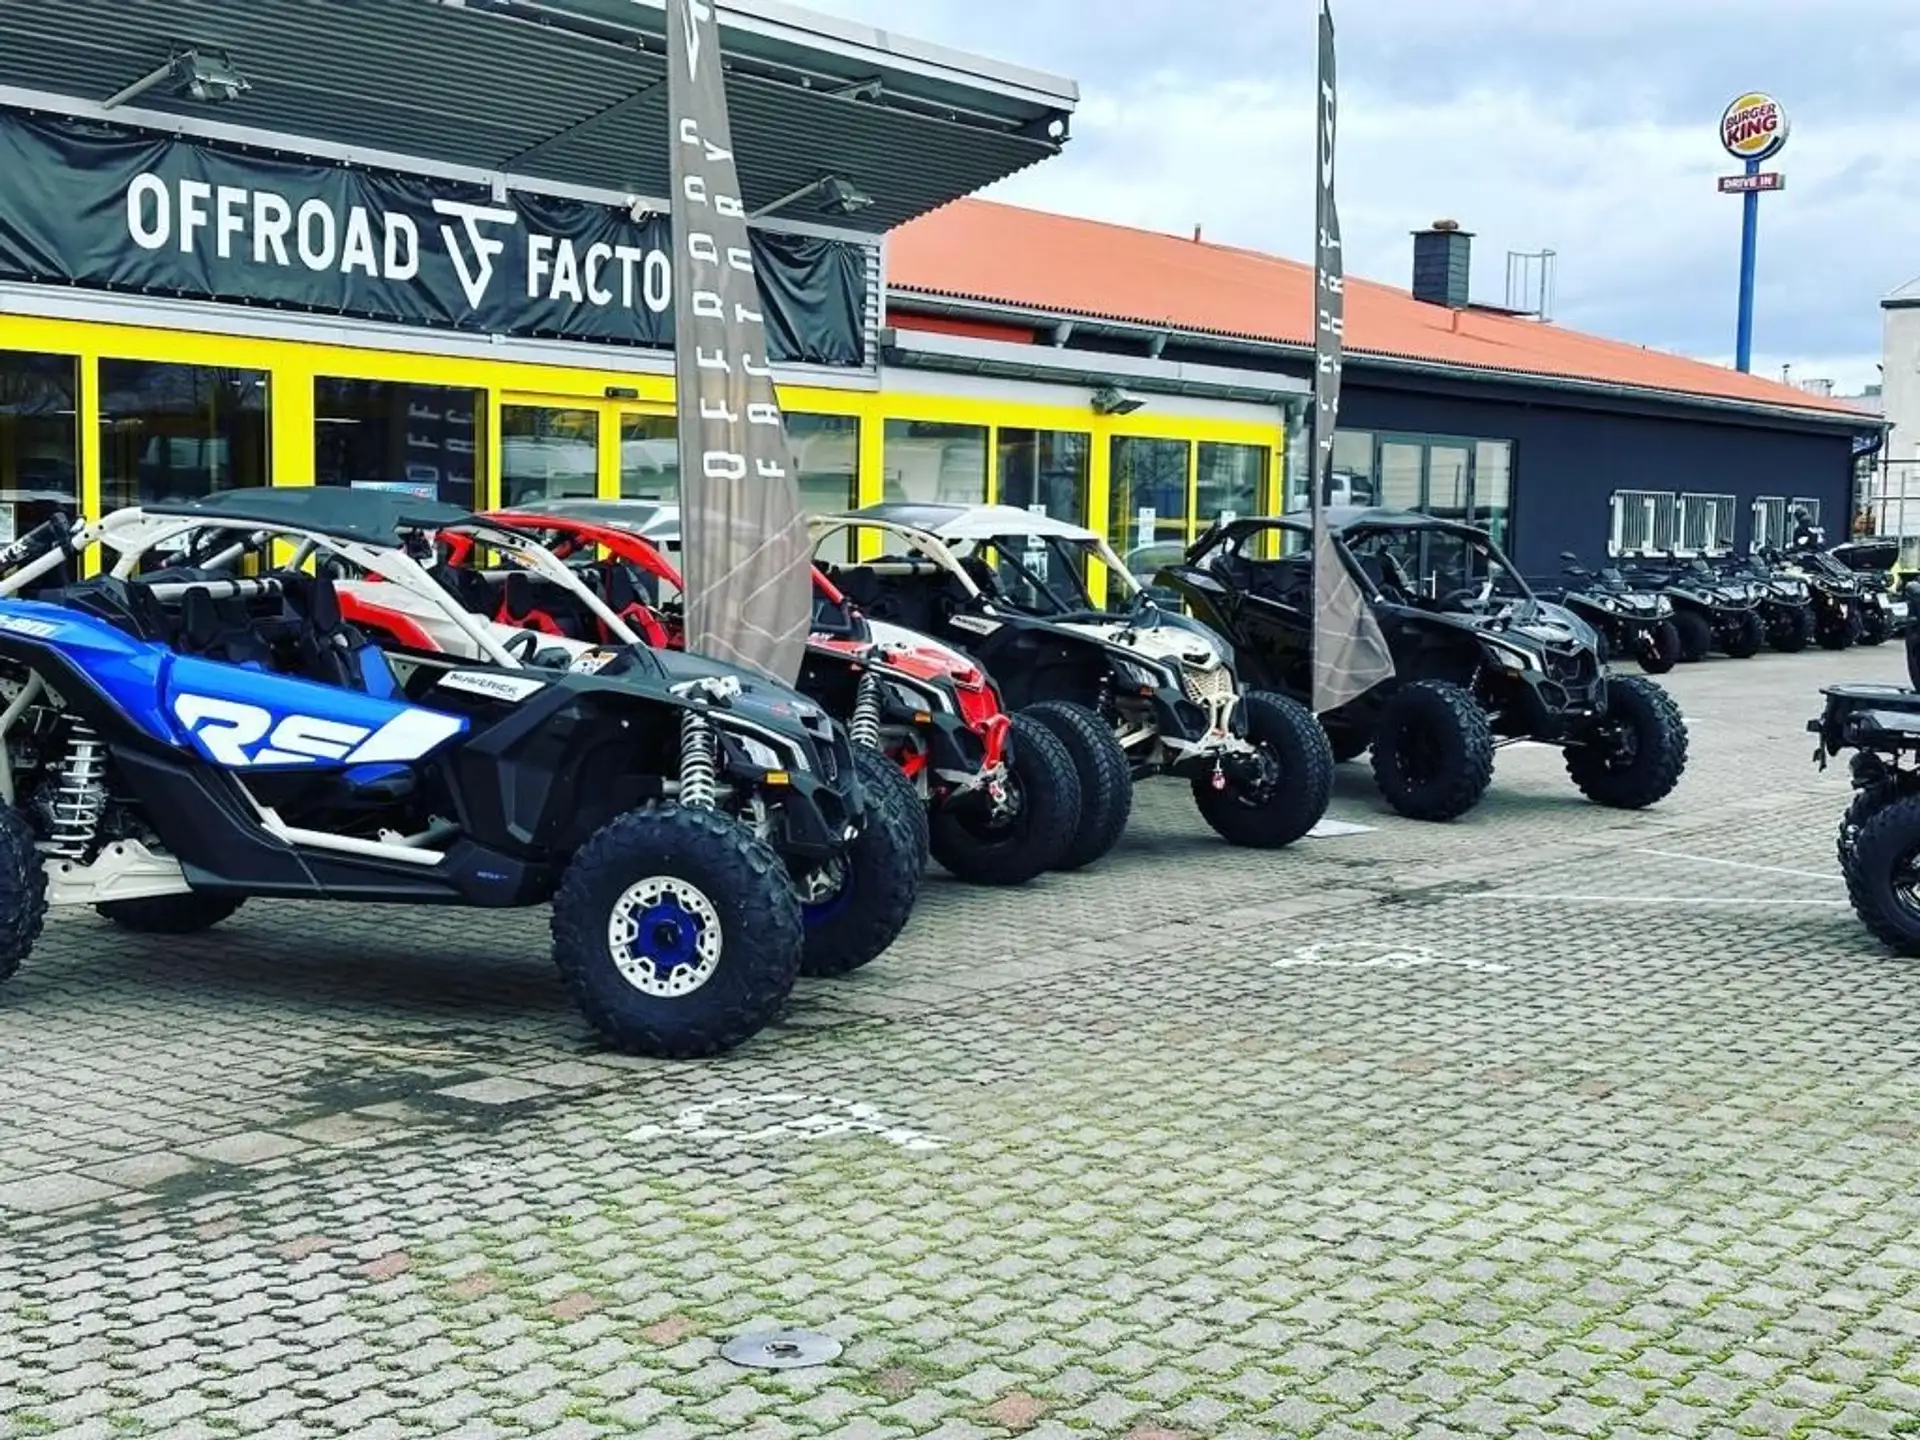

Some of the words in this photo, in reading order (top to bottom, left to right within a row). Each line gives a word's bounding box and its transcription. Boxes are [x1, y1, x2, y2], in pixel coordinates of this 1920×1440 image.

[1727, 103, 1777, 131] BURGER
[1727, 115, 1779, 147] KING
[1760, 175, 1773, 186] IN
[127, 172, 419, 282] OFFROAD
[527, 233, 672, 313] FACTO
[702, 138, 786, 478] FACTORY
